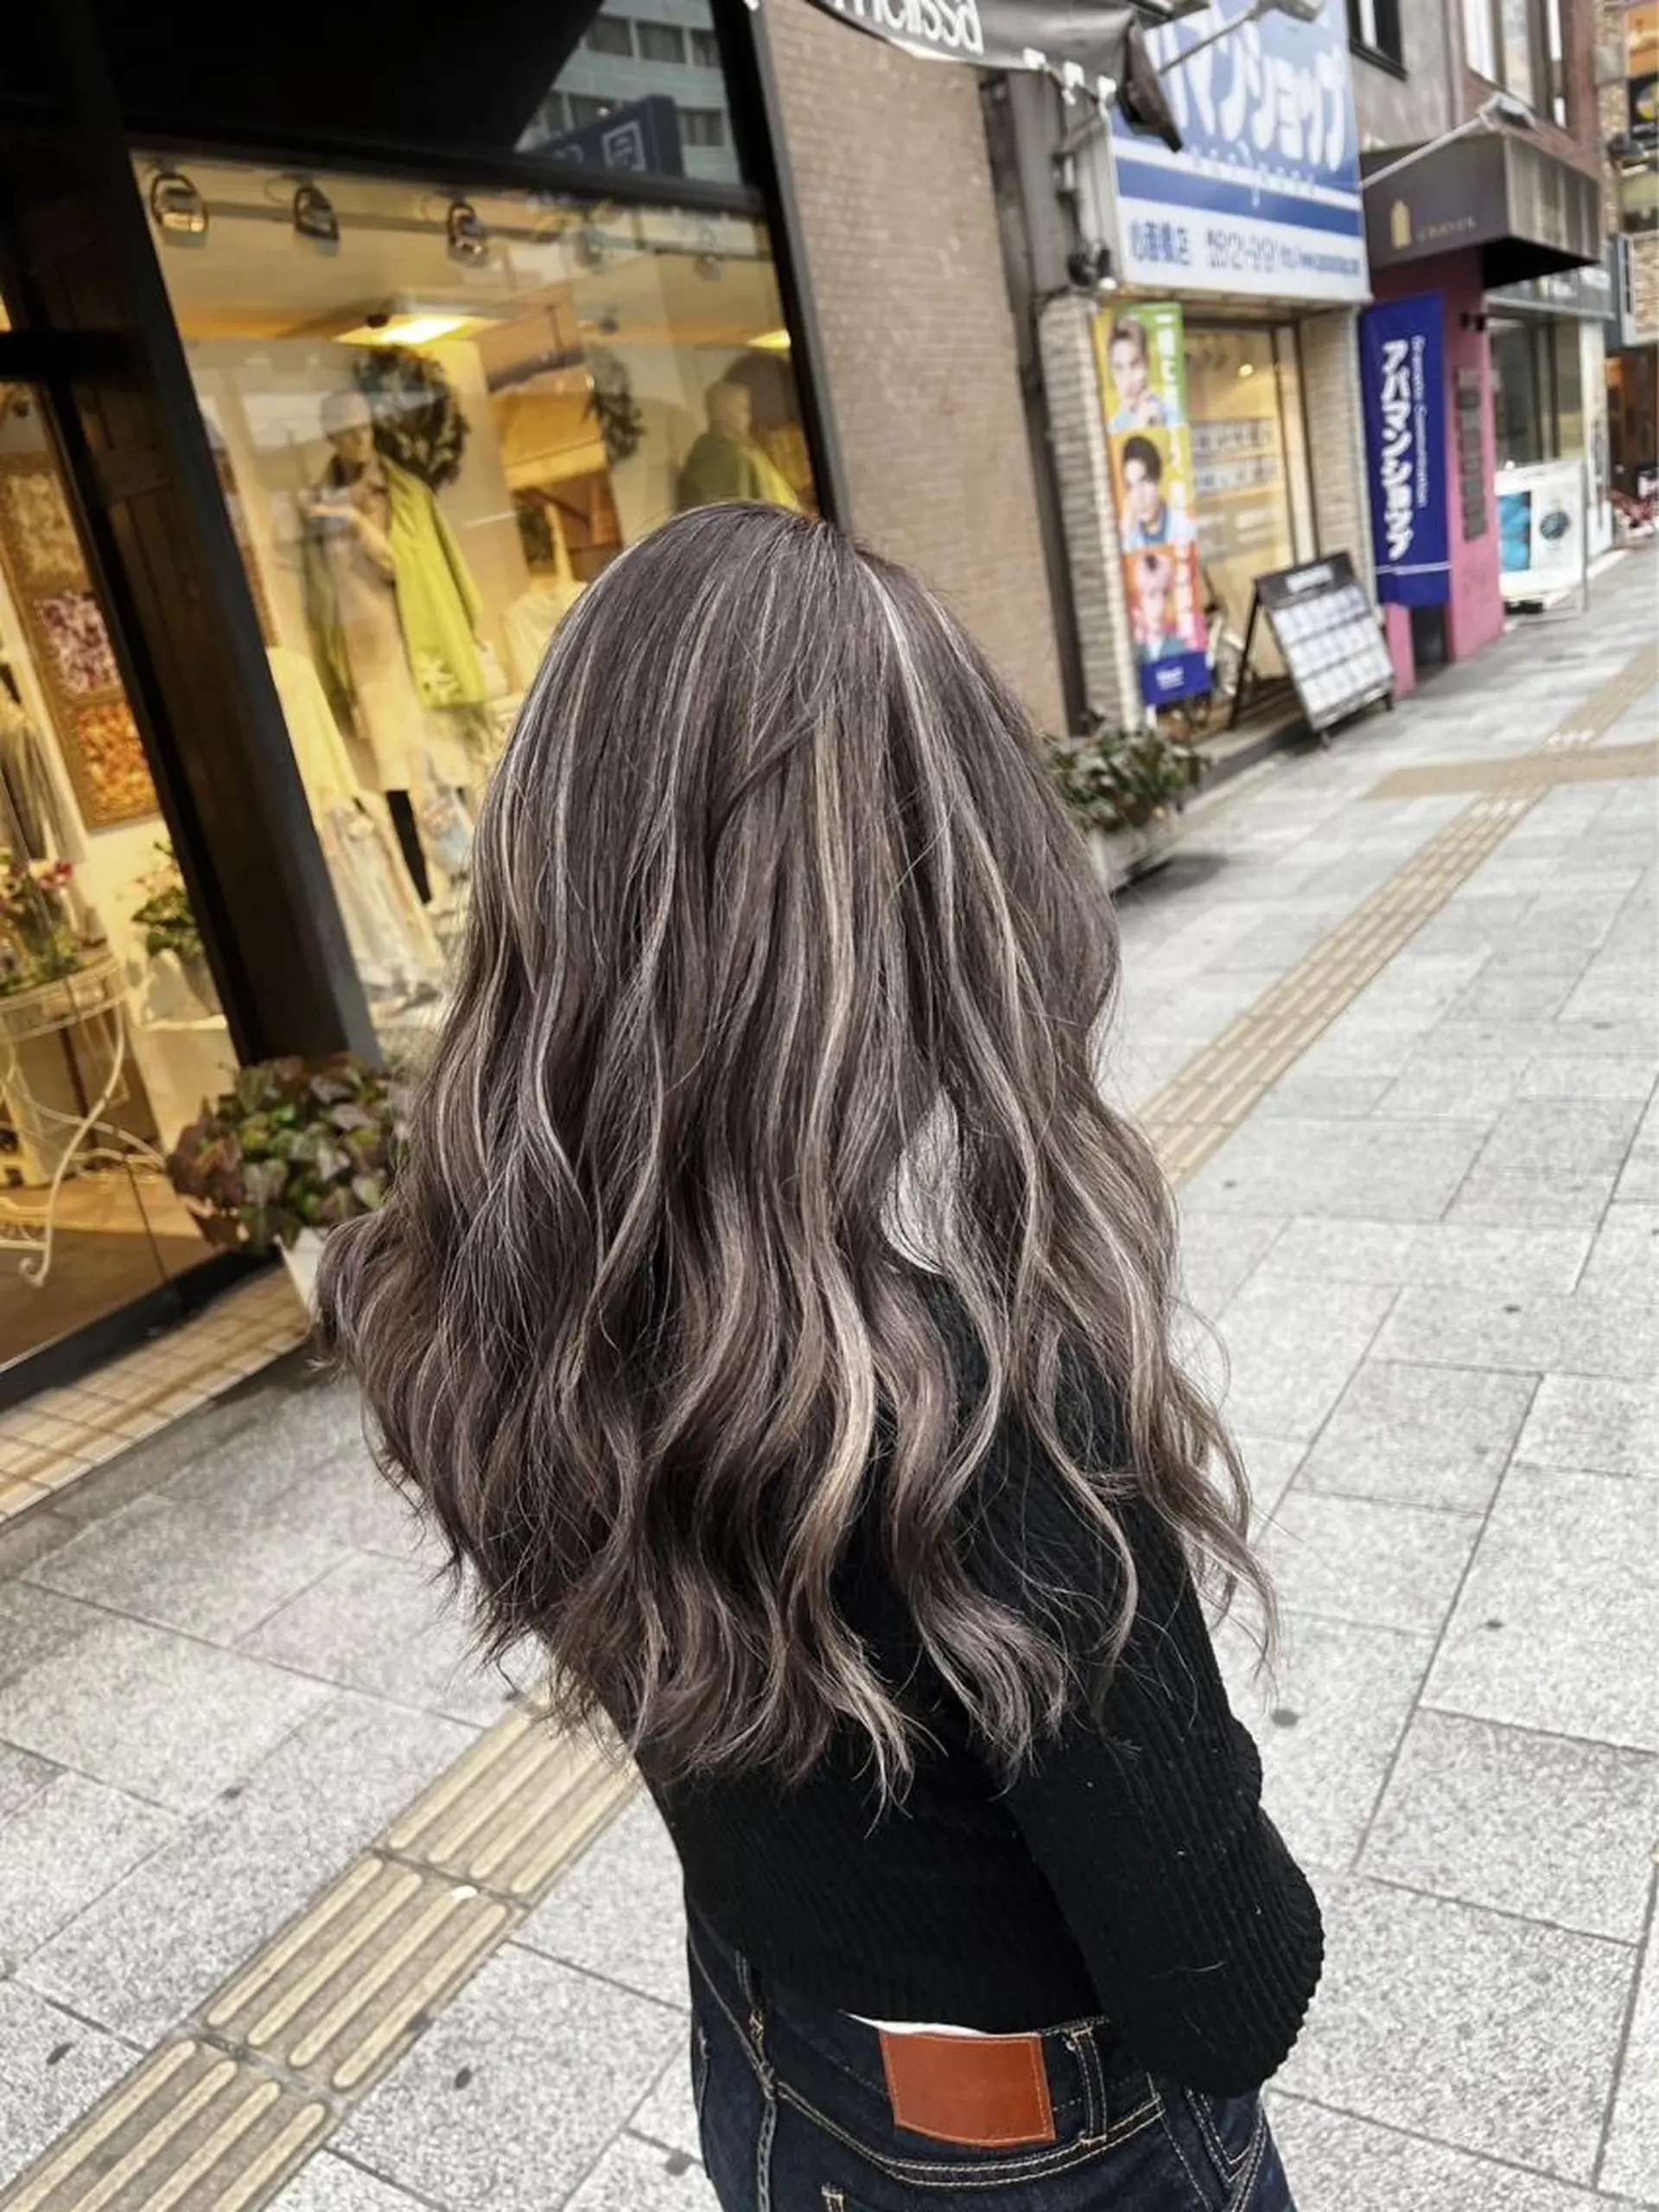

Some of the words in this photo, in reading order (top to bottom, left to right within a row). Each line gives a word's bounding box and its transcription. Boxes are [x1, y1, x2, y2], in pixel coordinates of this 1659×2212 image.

[1381, 339, 1414, 561] アパマンショップ
